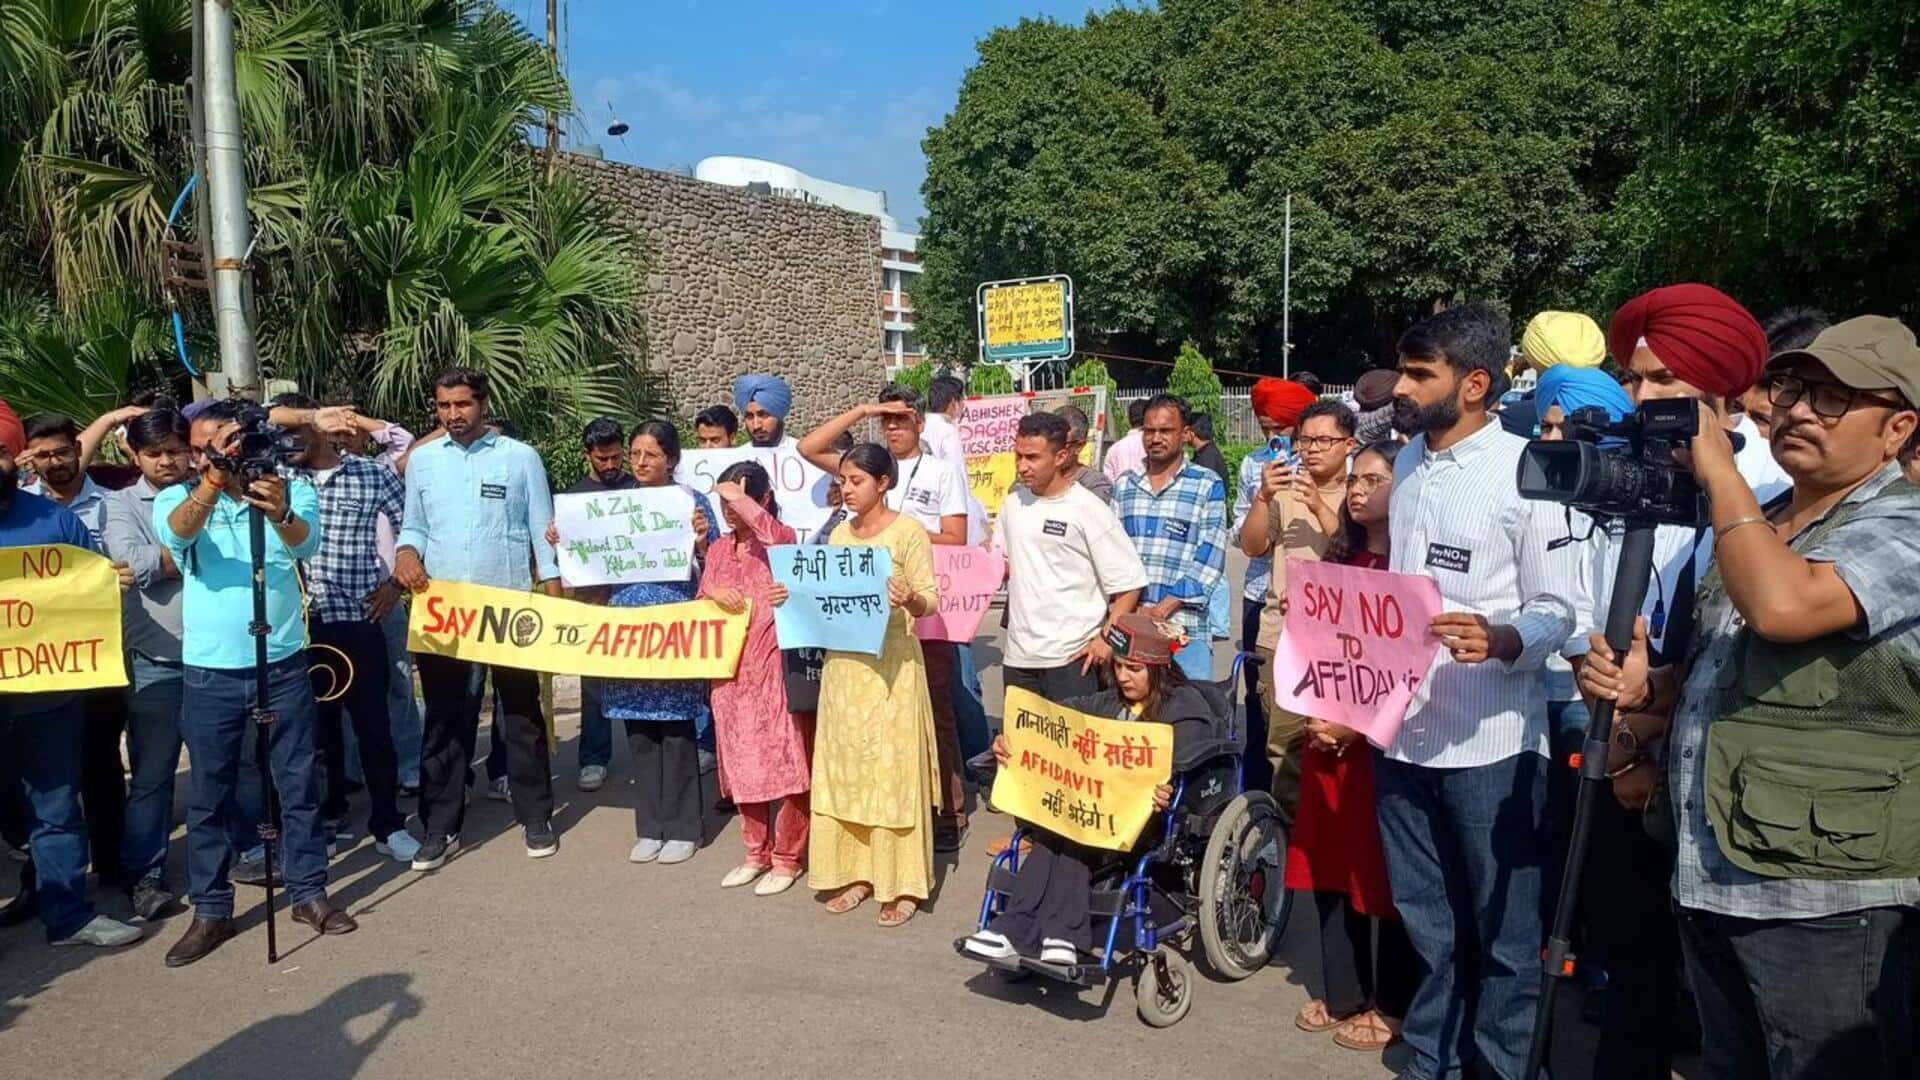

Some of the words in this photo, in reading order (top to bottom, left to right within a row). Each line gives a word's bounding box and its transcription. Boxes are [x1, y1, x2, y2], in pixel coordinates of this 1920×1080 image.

[958, 404, 1023, 424] ABHISHEK
[959, 418, 1019, 441] DAGAR
[22, 547, 63, 579] NO
[949, 553, 971, 571] NO
[0, 599, 34, 628] TO
[940, 593, 991, 613] DAVIT
[1304, 582, 1343, 625] SAY
[1359, 592, 1403, 639] NO
[423, 596, 477, 639] SAY
[477, 605, 543, 648] NO
[551, 624, 582, 646] TO
[586, 619, 728, 660] AFFIDAVIT
[0, 639, 105, 680] IDAVIT
[1336, 632, 1363, 660] TO
[1016, 707, 1070, 749] तानाशाही
[1072, 728, 1101, 764] नहीं
[1104, 735, 1157, 770] सहेंगे
[1020, 750, 1104, 799] AFFIDAVIT
[1042, 788, 1064, 818] नहीं
